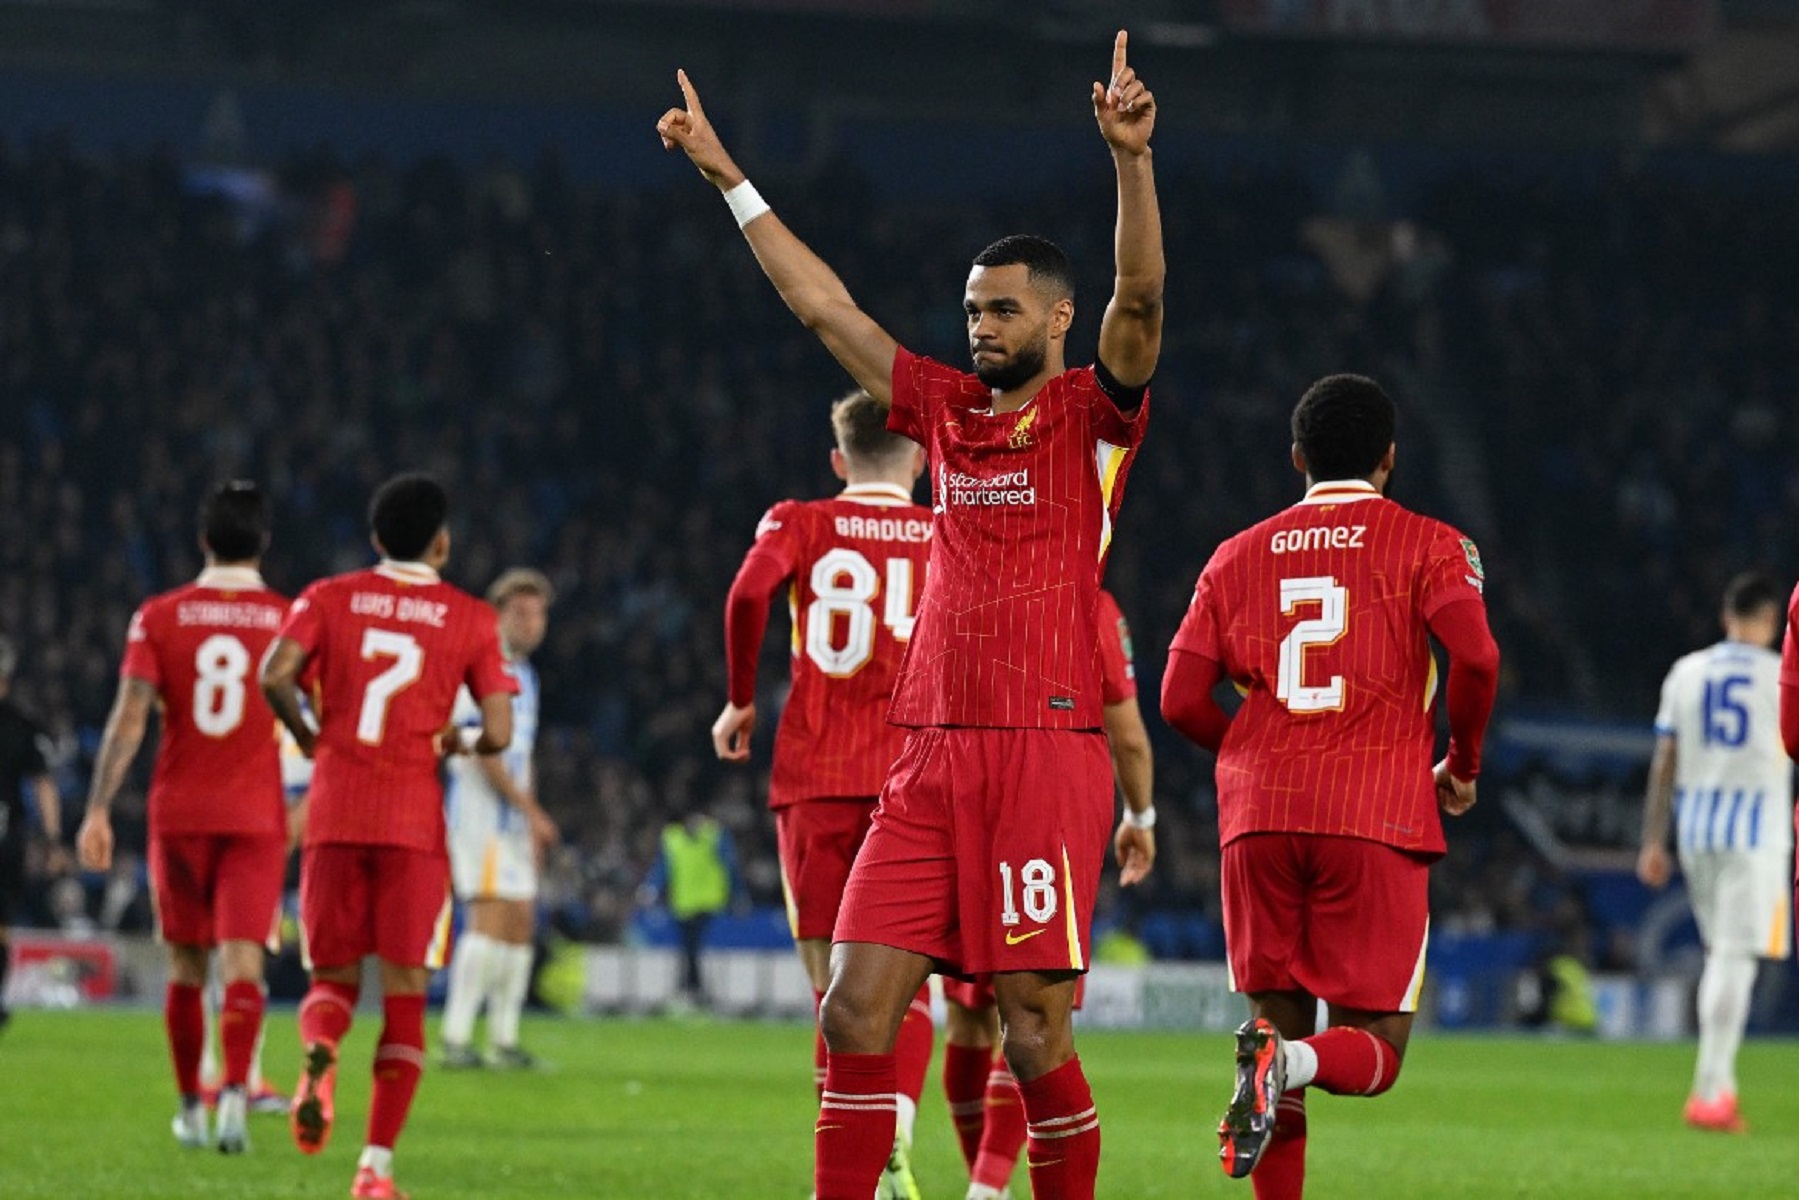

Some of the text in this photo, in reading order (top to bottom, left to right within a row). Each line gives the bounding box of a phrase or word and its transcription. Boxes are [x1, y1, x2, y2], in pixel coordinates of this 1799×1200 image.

[835, 516, 934, 542] BRADLEY
[1271, 526, 1367, 554] GOMEZ
[350, 592, 394, 618] LUIS
[1277, 576, 1349, 714] 2
[193, 634, 249, 737] 8
[357, 627, 424, 745] 7
[1702, 675, 1751, 748] 15
[999, 859, 1057, 926] 18
